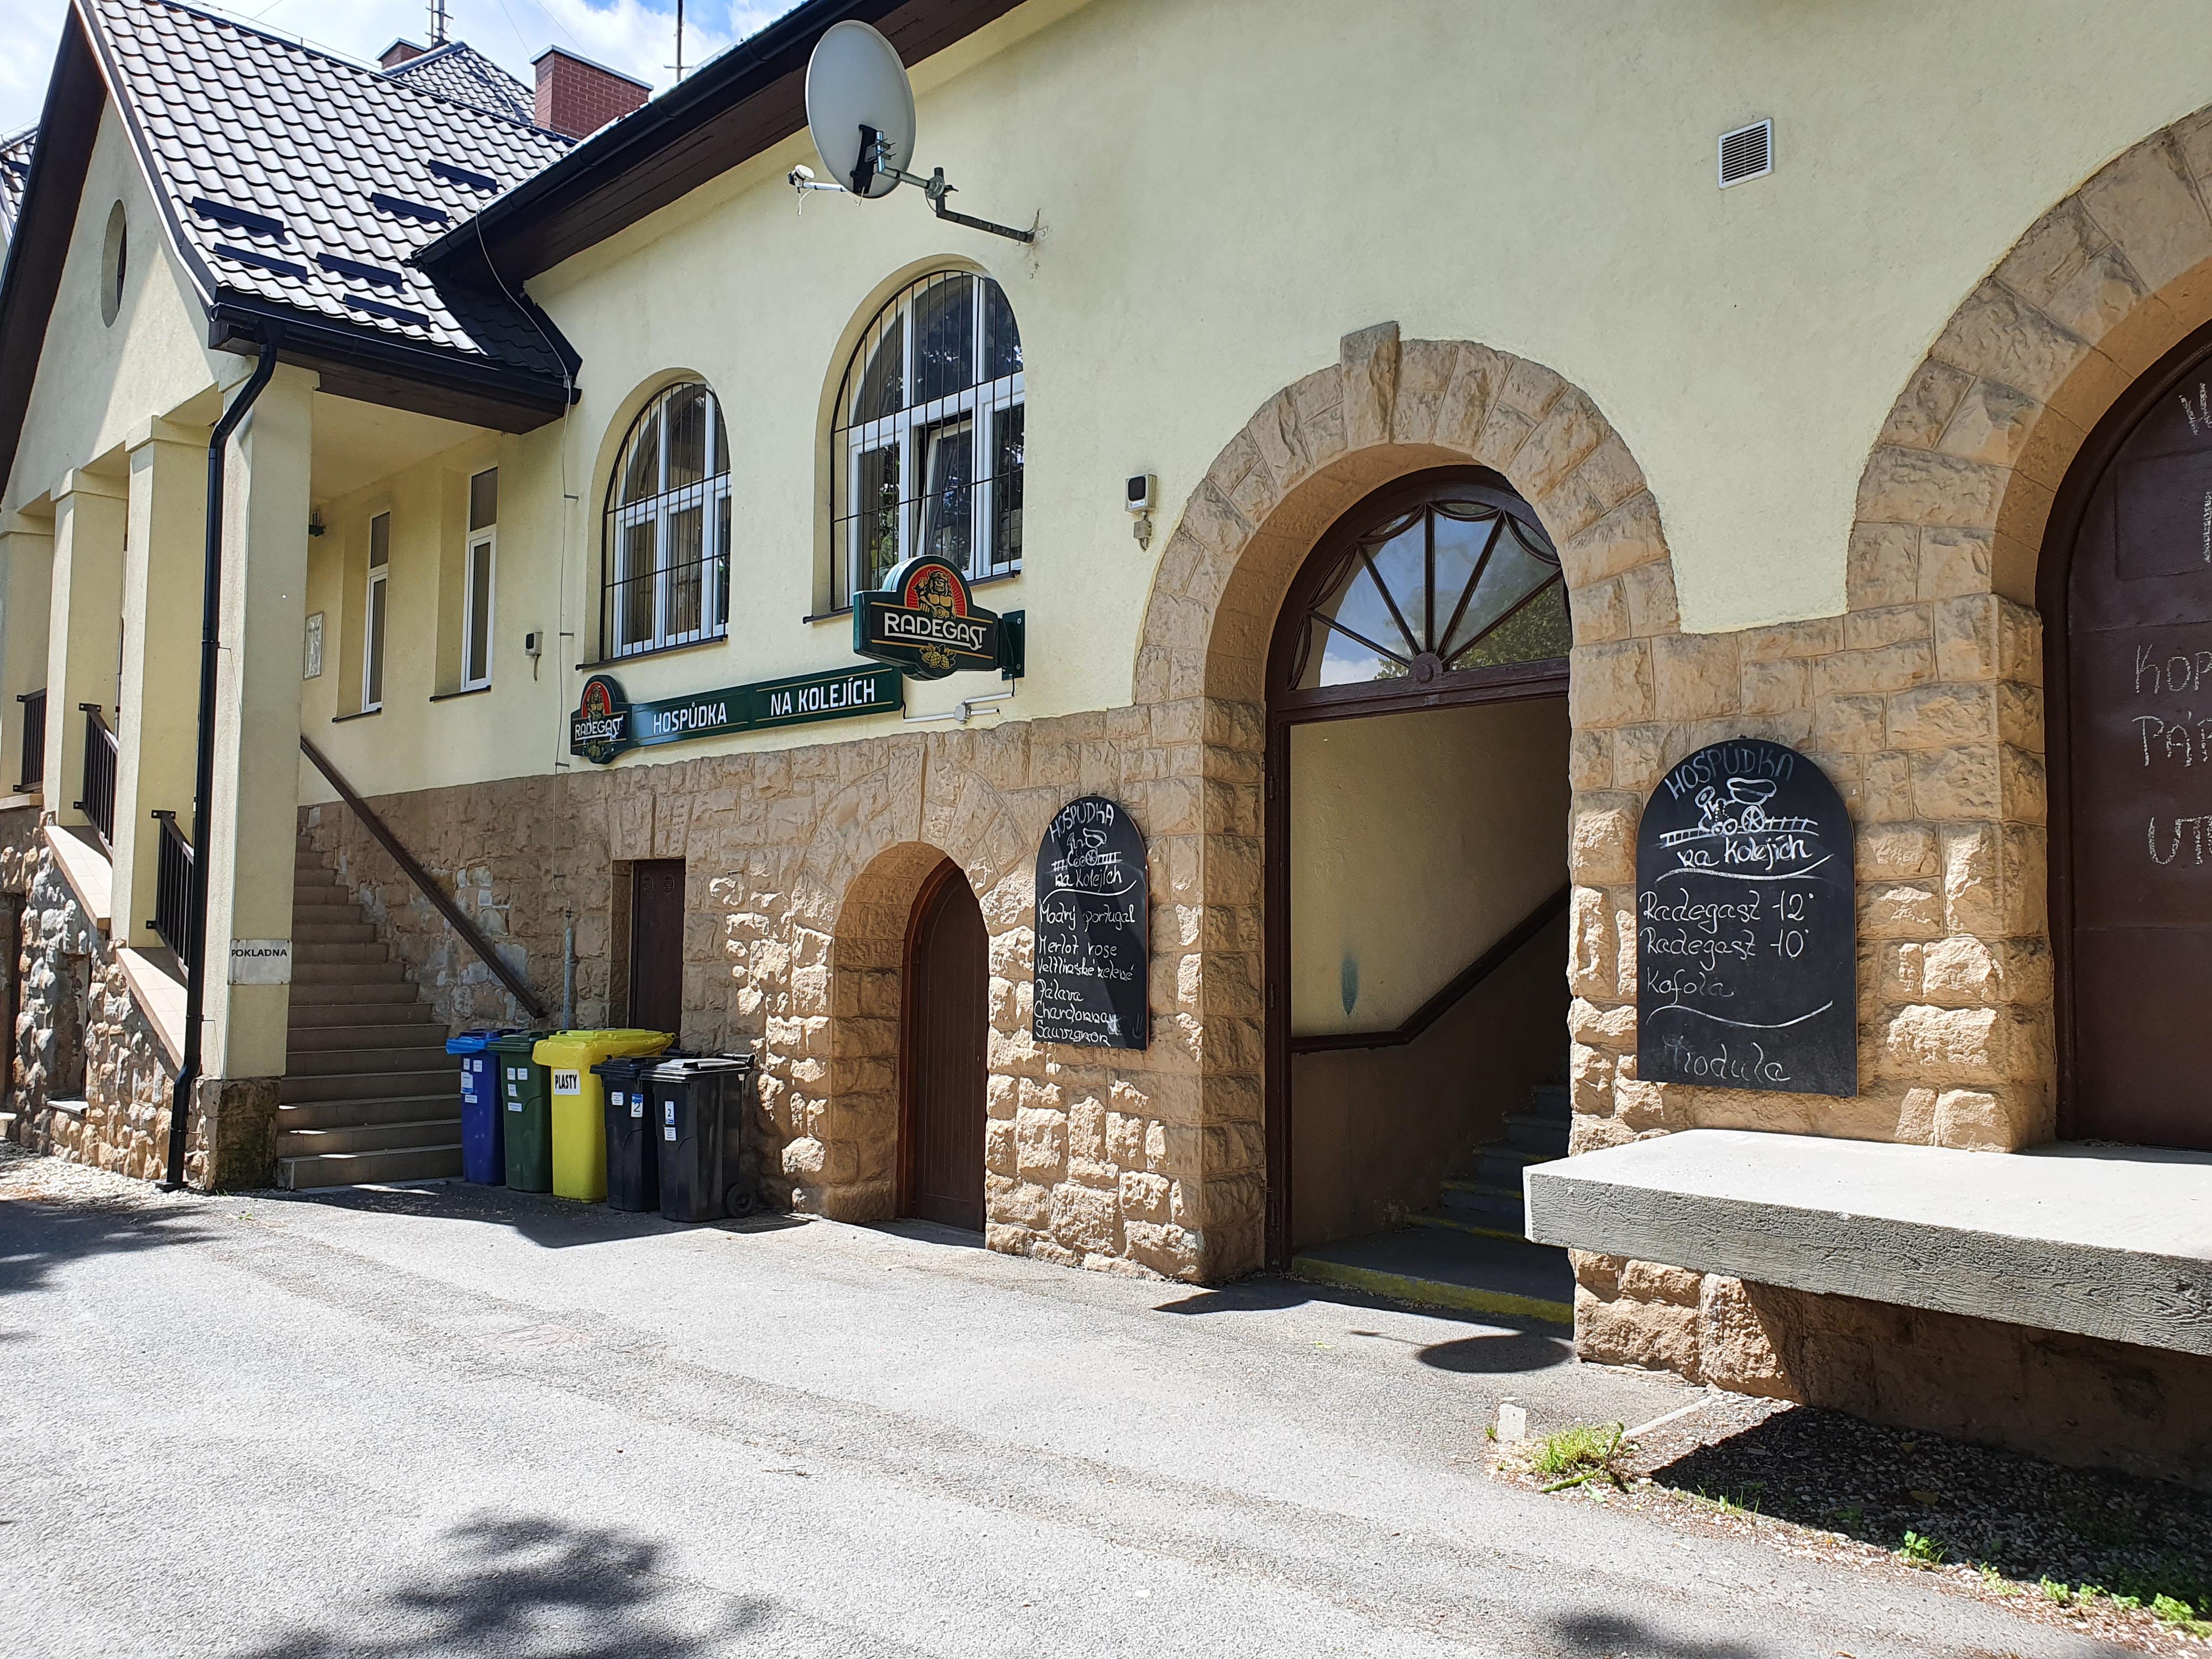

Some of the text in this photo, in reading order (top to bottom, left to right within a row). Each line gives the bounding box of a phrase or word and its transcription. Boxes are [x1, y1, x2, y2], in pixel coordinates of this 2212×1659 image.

[884, 612, 987, 651] RADEGAST
[653, 677, 875, 735] HOSPŮDKA NA KOLEJÍCH
[575, 714, 624, 741] RADEGAST
[2148, 814, 2212, 865] UT
[1639, 888, 1761, 934] Radegast
[231, 949, 288, 957] POKLADNA
[1039, 933, 1118, 958] Merlot rose
[1639, 926, 1756, 971] Radegast
[1647, 967, 1735, 1005] Kofola
[555, 1074, 577, 1089] PLASTY
[633, 1102, 641, 1113] 2
[667, 1108, 672, 1117] 2
